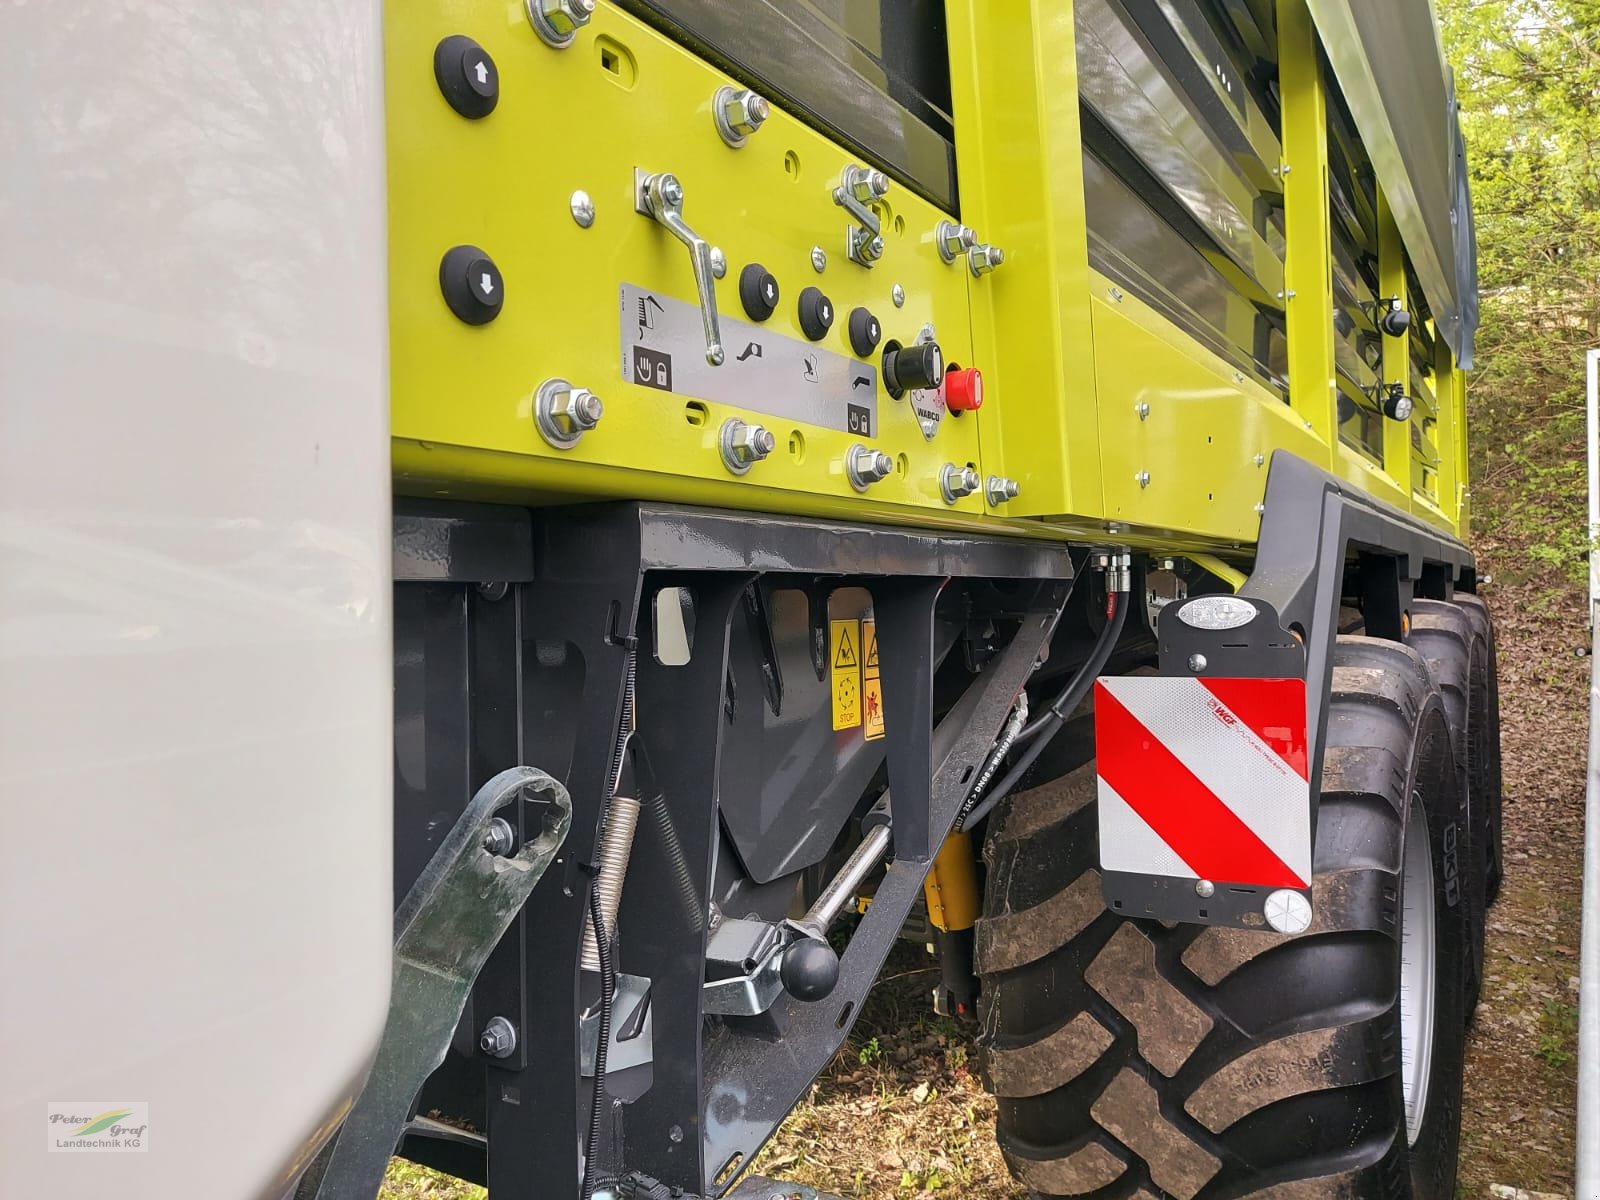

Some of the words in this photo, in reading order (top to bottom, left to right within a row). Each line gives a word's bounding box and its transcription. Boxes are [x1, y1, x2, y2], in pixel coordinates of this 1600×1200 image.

[917, 407, 940, 422] WABCO
[839, 712, 855, 723] STOP
[1214, 706, 1238, 726] WGF
[1443, 821, 1460, 907] BKT
